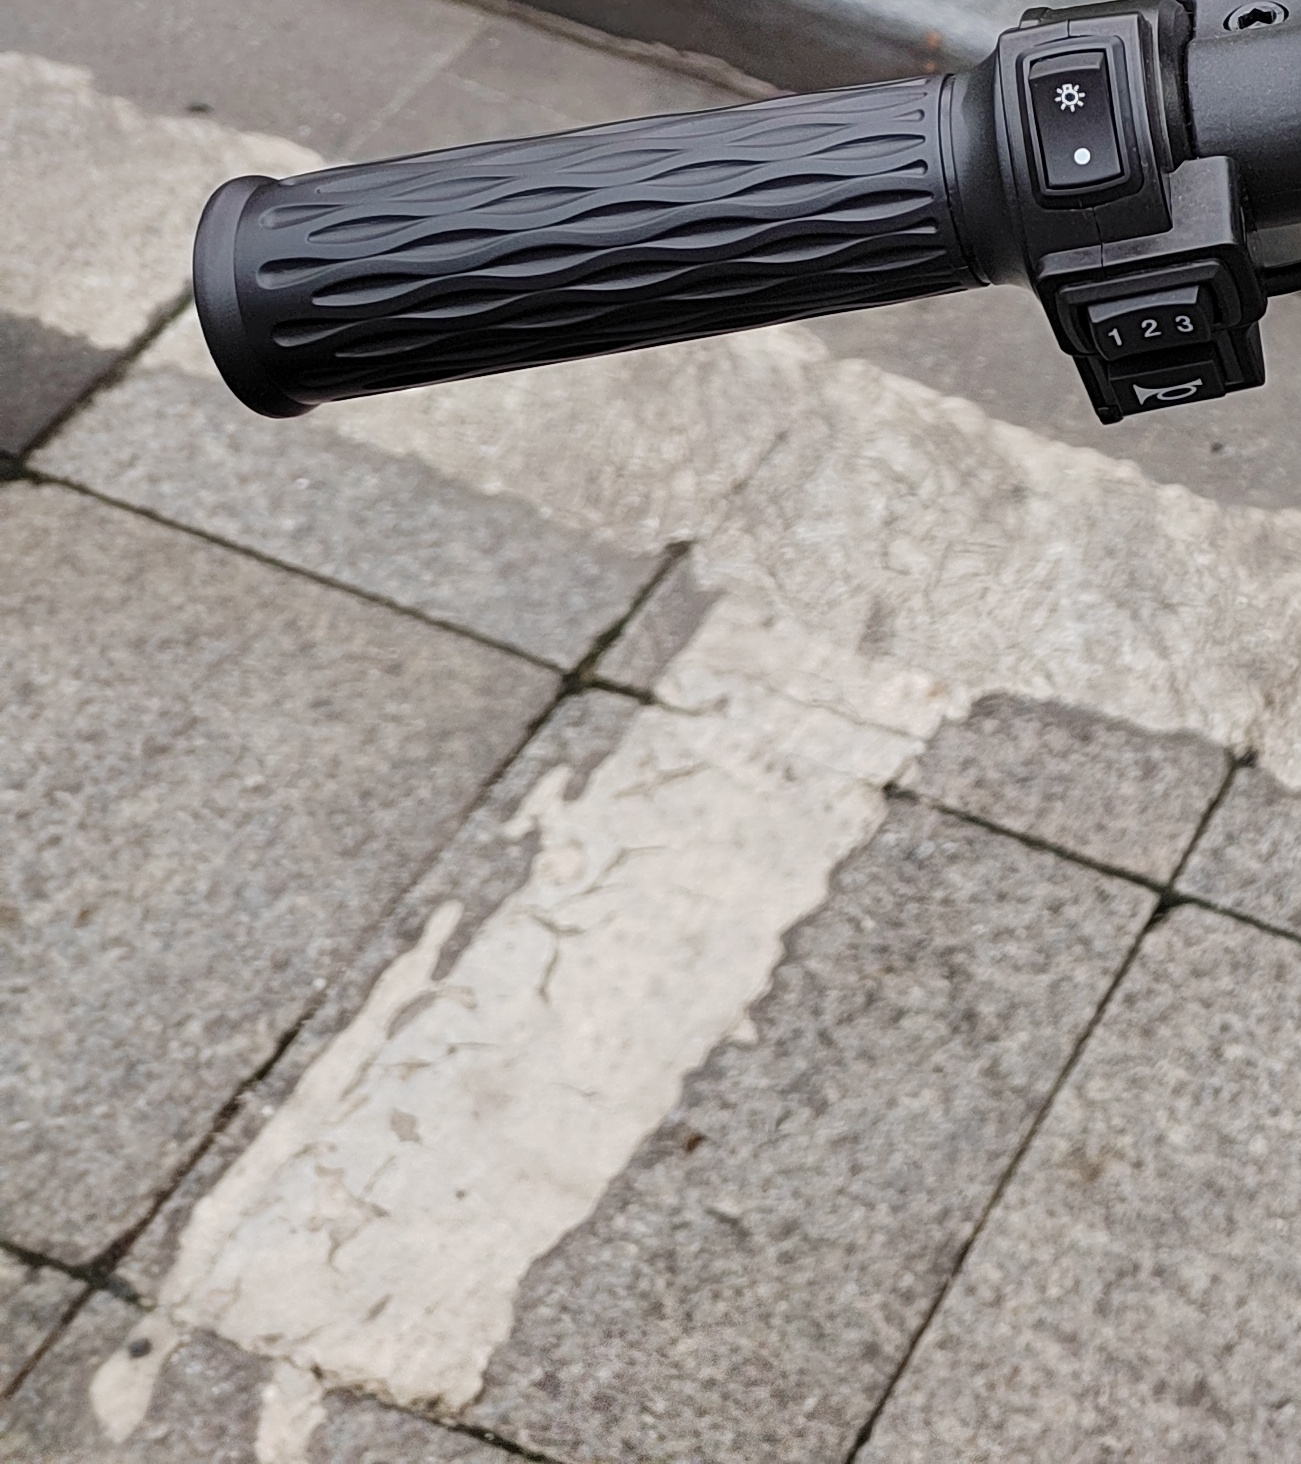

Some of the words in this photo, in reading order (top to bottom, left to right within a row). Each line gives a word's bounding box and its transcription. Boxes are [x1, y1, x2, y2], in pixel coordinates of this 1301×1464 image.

[1107, 327, 1123, 346] 1
[1141, 319, 1162, 338] 2
[1175, 315, 1194, 333] 3
